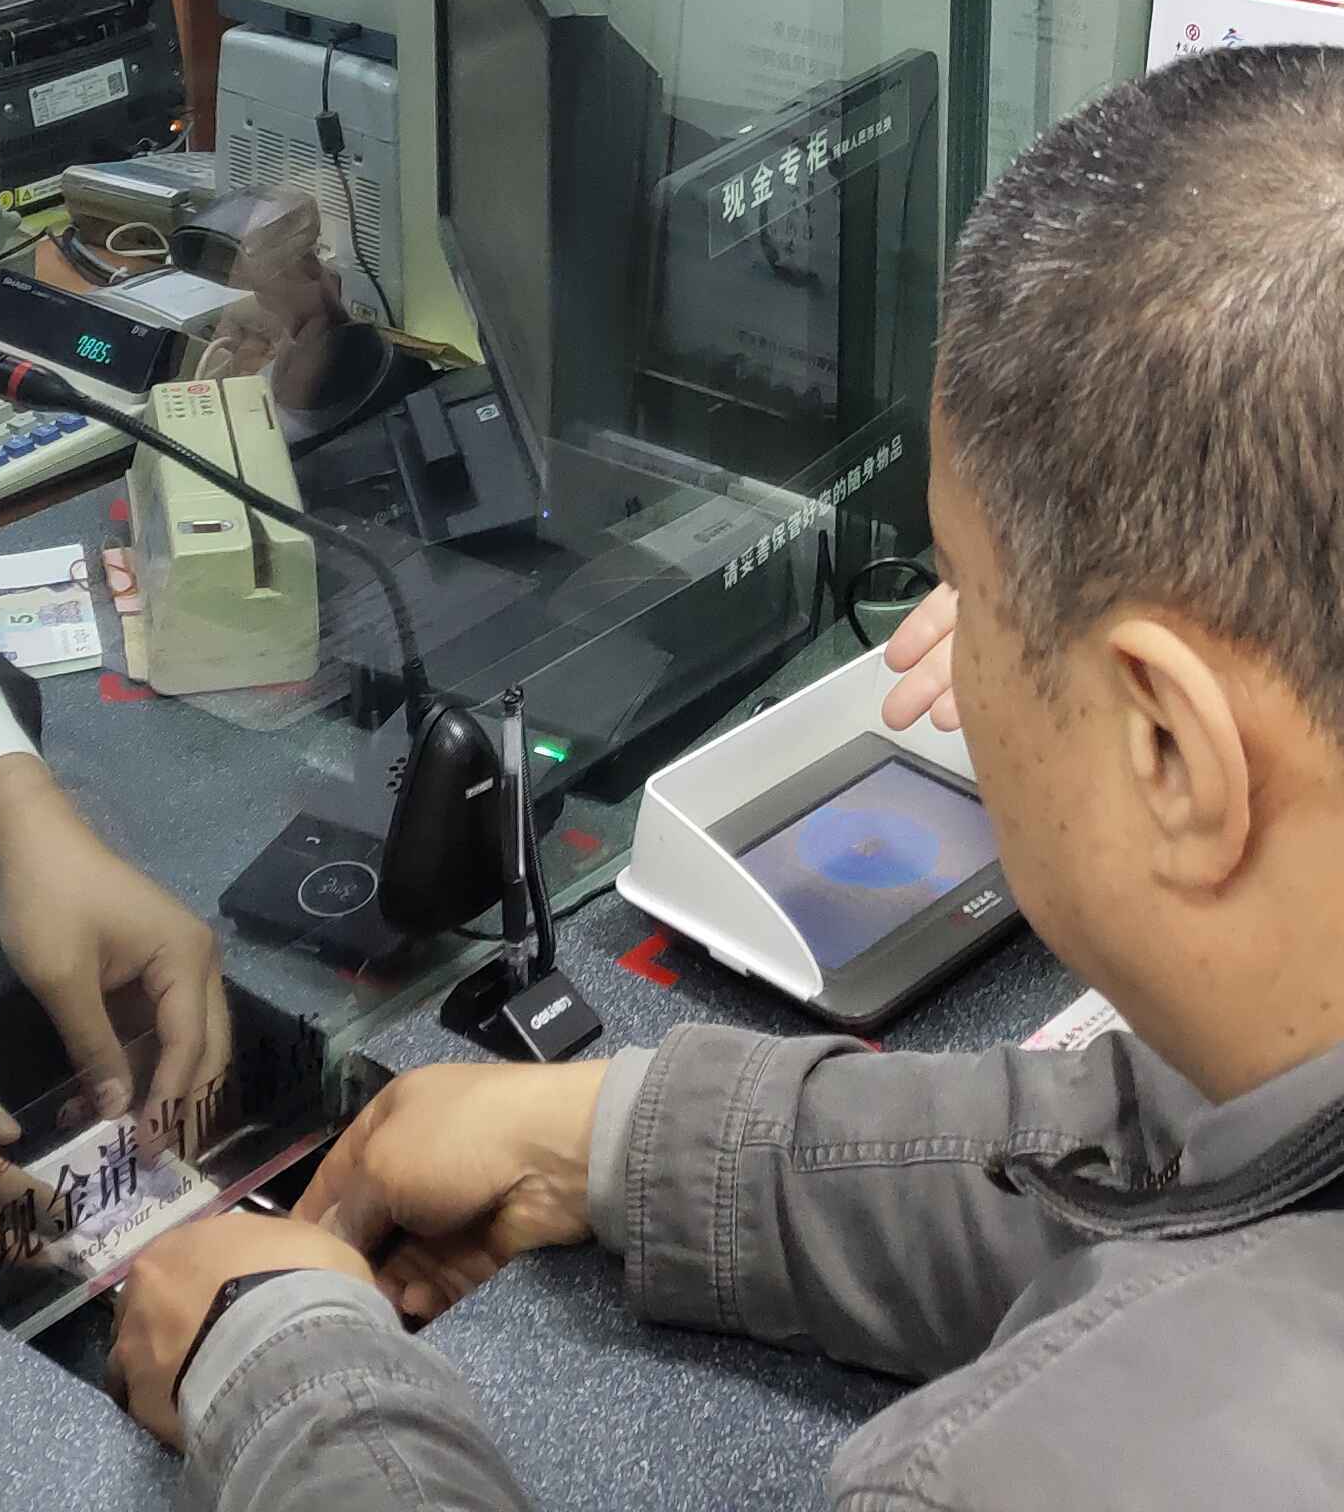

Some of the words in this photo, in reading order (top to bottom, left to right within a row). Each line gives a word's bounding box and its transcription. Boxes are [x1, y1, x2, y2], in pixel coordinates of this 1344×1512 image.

[721, 128, 829, 224] 现金专柜
[111, 1202, 154, 1248] your
